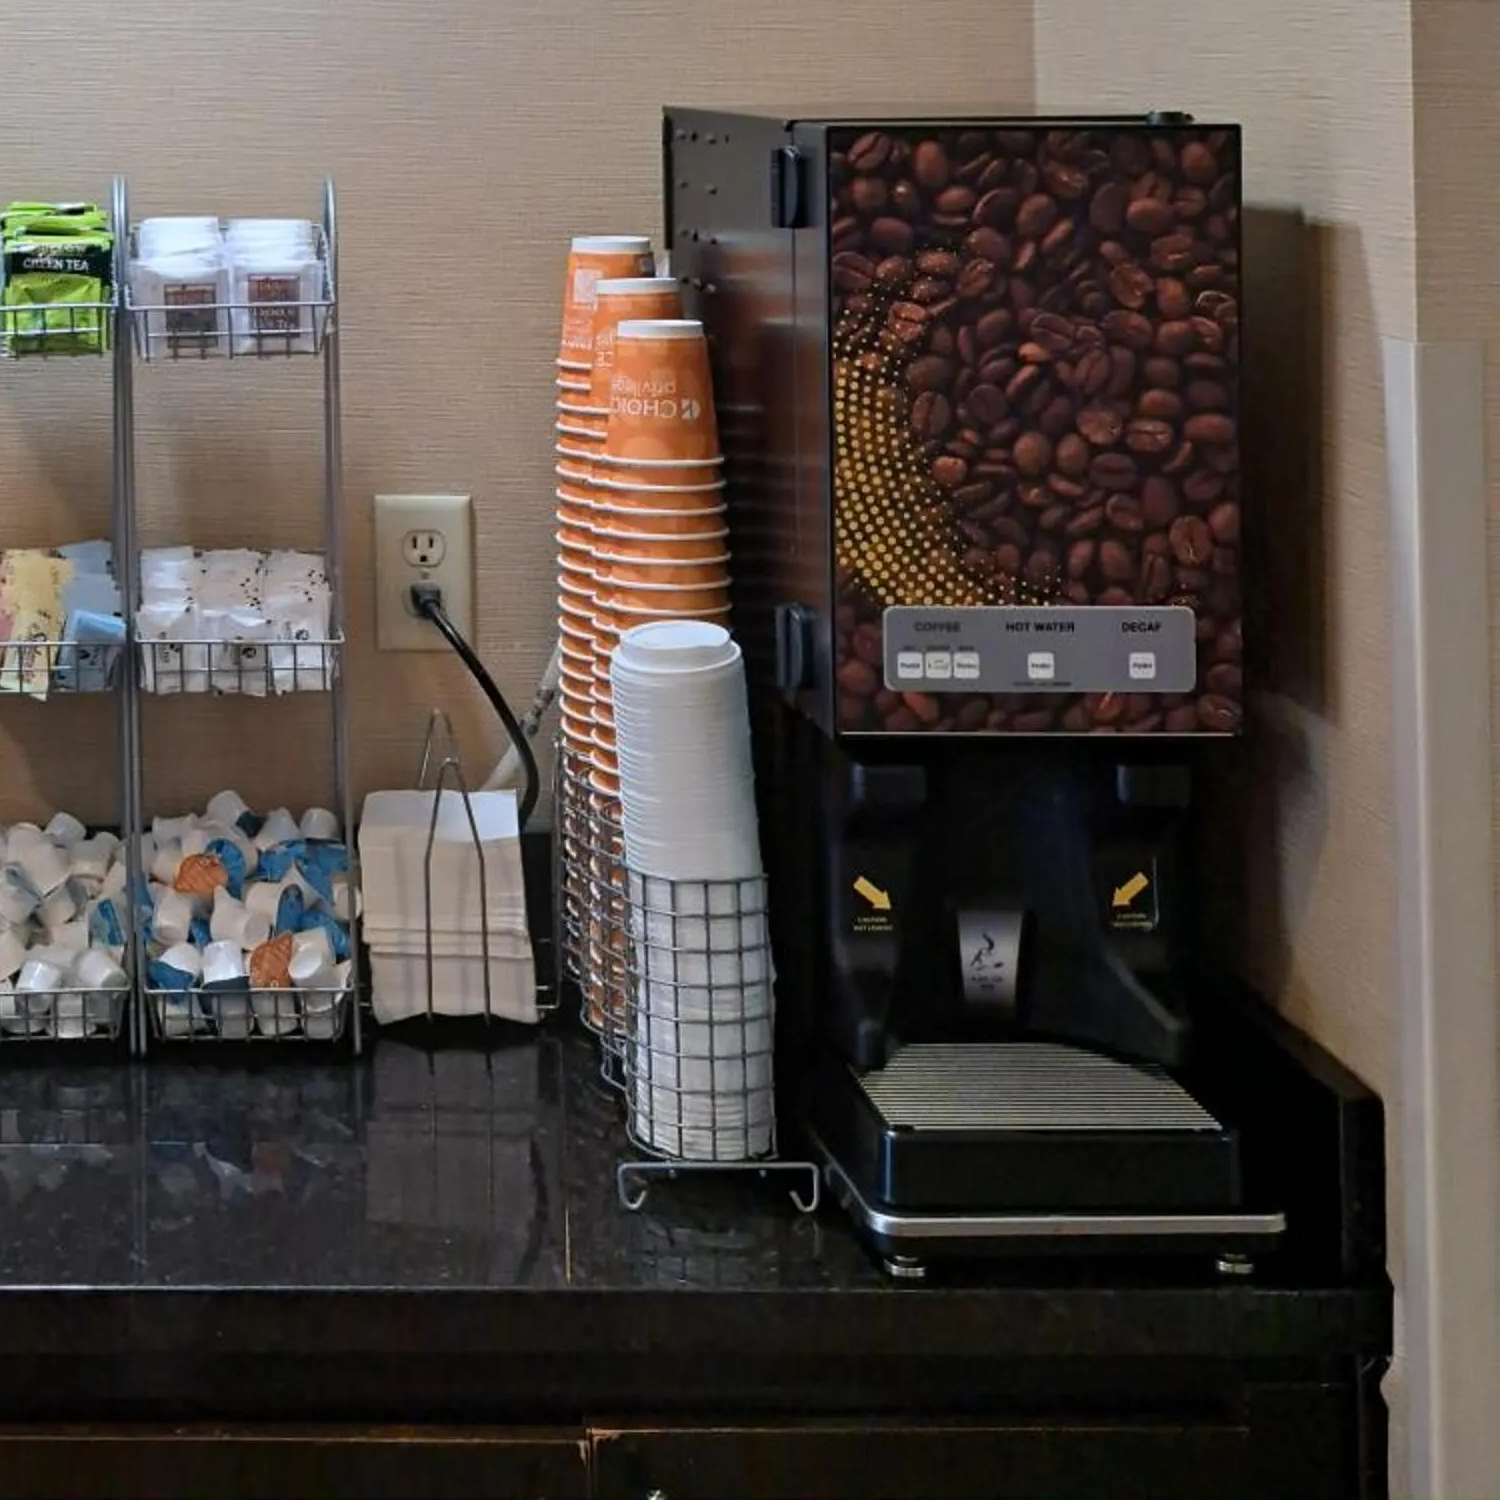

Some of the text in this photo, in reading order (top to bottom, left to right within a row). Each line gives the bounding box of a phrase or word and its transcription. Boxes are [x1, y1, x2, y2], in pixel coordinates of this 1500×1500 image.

[66, 258, 90, 273] TEA
[913, 620, 962, 633] COFFEE
[1005, 620, 1075, 633] HOT WATER
[1121, 620, 1162, 633] DECAF
